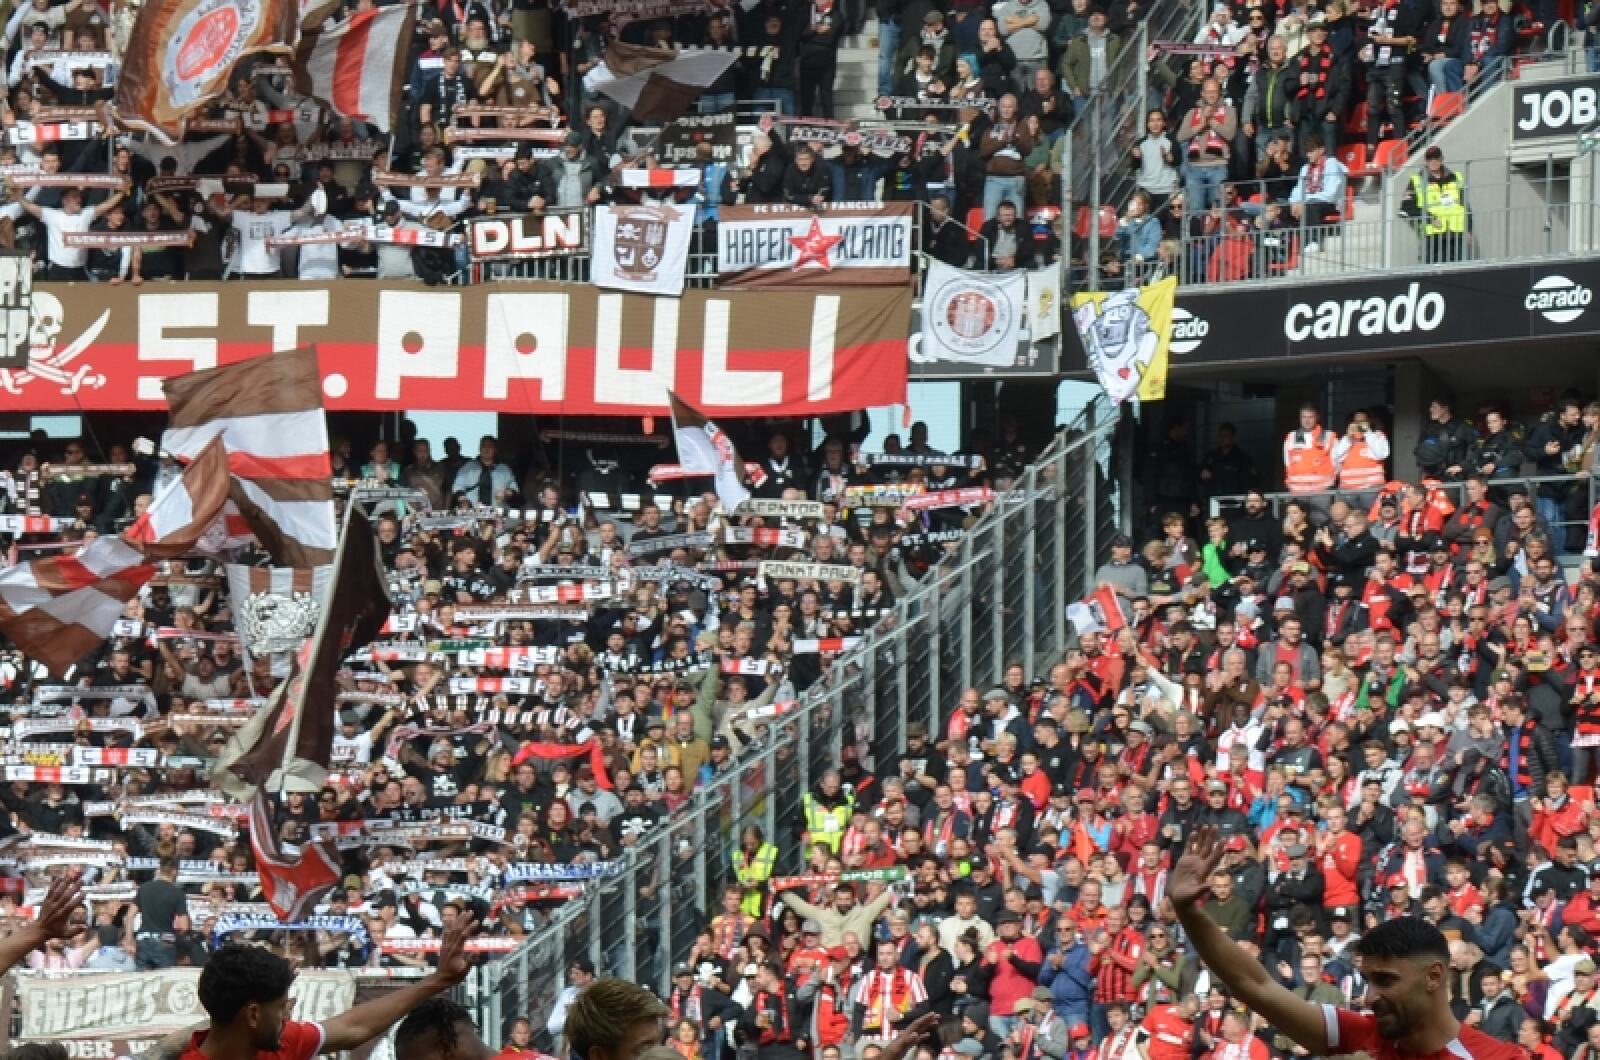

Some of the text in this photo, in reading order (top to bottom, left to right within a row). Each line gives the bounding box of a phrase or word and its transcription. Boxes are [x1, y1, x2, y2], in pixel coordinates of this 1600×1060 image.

[1517, 87, 1598, 131] JOB
[474, 214, 581, 255] DLN
[725, 223, 905, 265] HAFEN KLANG
[1284, 282, 1445, 341] carado
[1524, 285, 1593, 310] carado
[376, 290, 840, 406] PAULI
